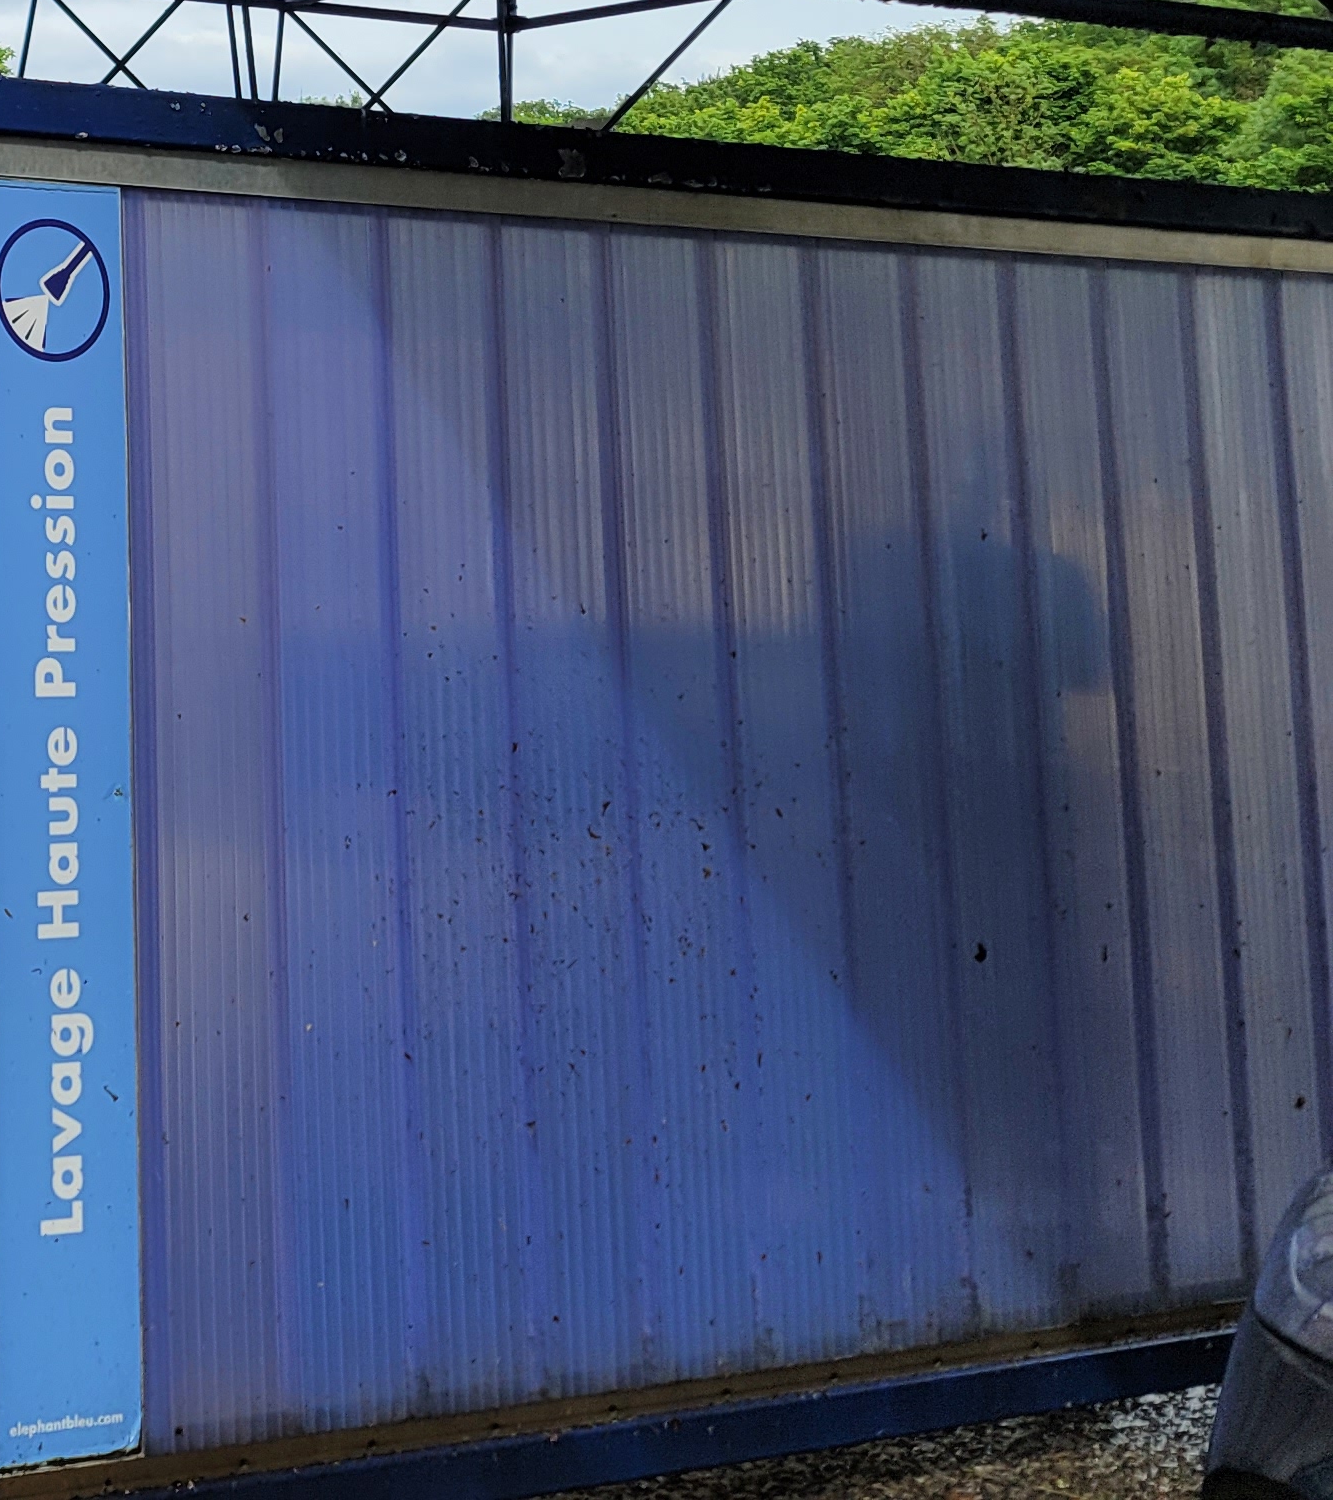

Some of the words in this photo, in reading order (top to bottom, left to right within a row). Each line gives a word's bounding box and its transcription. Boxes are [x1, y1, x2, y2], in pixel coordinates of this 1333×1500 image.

[30, 406, 77, 698] Pression
[36, 725, 80, 940] Haute
[39, 967, 94, 1237] Lavage
[8, 1413, 124, 1439] elephantbleu.com
